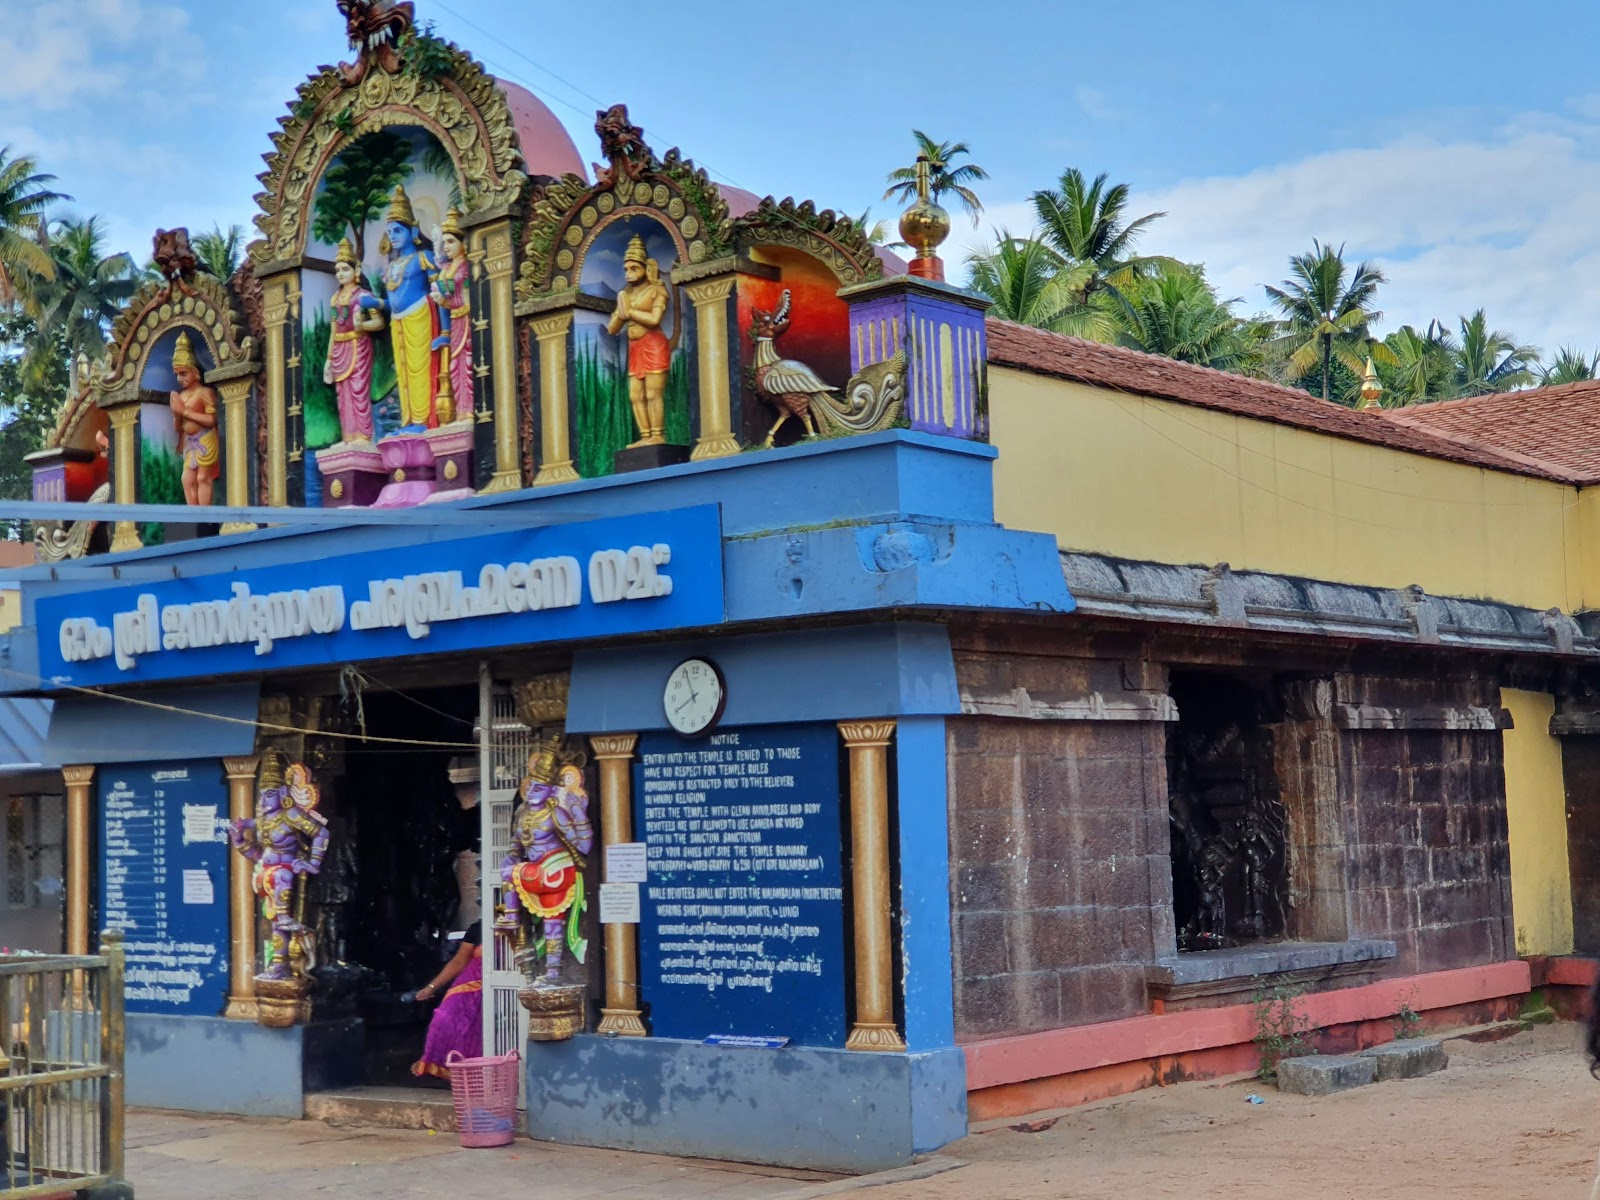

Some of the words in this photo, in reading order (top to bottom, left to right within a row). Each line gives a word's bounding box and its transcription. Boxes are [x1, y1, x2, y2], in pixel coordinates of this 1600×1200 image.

[113, 593, 160, 671] ശ്രീ
[710, 734, 740, 744] NOTICE
[644, 754, 666, 764] ENTRY
[667, 753, 683, 763] INTO
[684, 752, 698, 763] THE
[700, 751, 724, 762] TEMPLE
[726, 751, 733, 761] IS
[736, 750, 760, 761] DENIED
[764, 748, 775, 759] TO
[776, 748, 801, 759] THOSE
[644, 768, 661, 777] HAVE
[663, 767, 672, 777] NO
[674, 766, 702, 777] RESPECT
[703, 765, 717, 775] FOR
[718, 764, 746, 775] TEMPLE
[748, 763, 769, 774] RULES
[678, 780, 685, 790] IS
[686, 779, 722, 789] RESTRICTED
[724, 778, 739, 788] ONLY
[740, 777, 750, 788] TO
[750, 777, 763, 787] THE
[764, 776, 794, 787] BELIEVERS
[675, 793, 706, 803] RELIGION
[645, 807, 666, 818] ENTER
[668, 807, 680, 818] THE
[683, 807, 708, 817] TEMPLE
[711, 806, 729, 816] WITH
[731, 805, 752, 816] CLEAN
[790, 804, 802, 814] AND
[804, 803, 822, 813] BODY
[646, 821, 676, 831] DEVOTEES
[678, 821, 688, 831] ARE
[689, 820, 701, 830] NOT
[738, 819, 748, 830] USE
[750, 819, 774, 829] CAMERA
[776, 818, 784, 828] OR
[784, 817, 804, 828] VIDEO
[648, 834, 664, 843] WITH
[674, 833, 686, 844] THE
[690, 833, 720, 843] SANCTUM
[648, 847, 664, 858] KEEP
[666, 847, 682, 857] YOUR
[683, 847, 702, 857] SHOES
[734, 846, 748, 856] THE
[750, 846, 774, 856] TEMPLE
[648, 888, 666, 899] MALE
[667, 887, 696, 899] DEVOTEES
[696, 888, 714, 899] SHALL
[714, 887, 727, 899] NOT
[729, 887, 748, 899] ENTER
[748, 887, 760, 899] THE
[657, 905, 682, 916] WEARING
[779, 906, 800, 917] LUNGI
